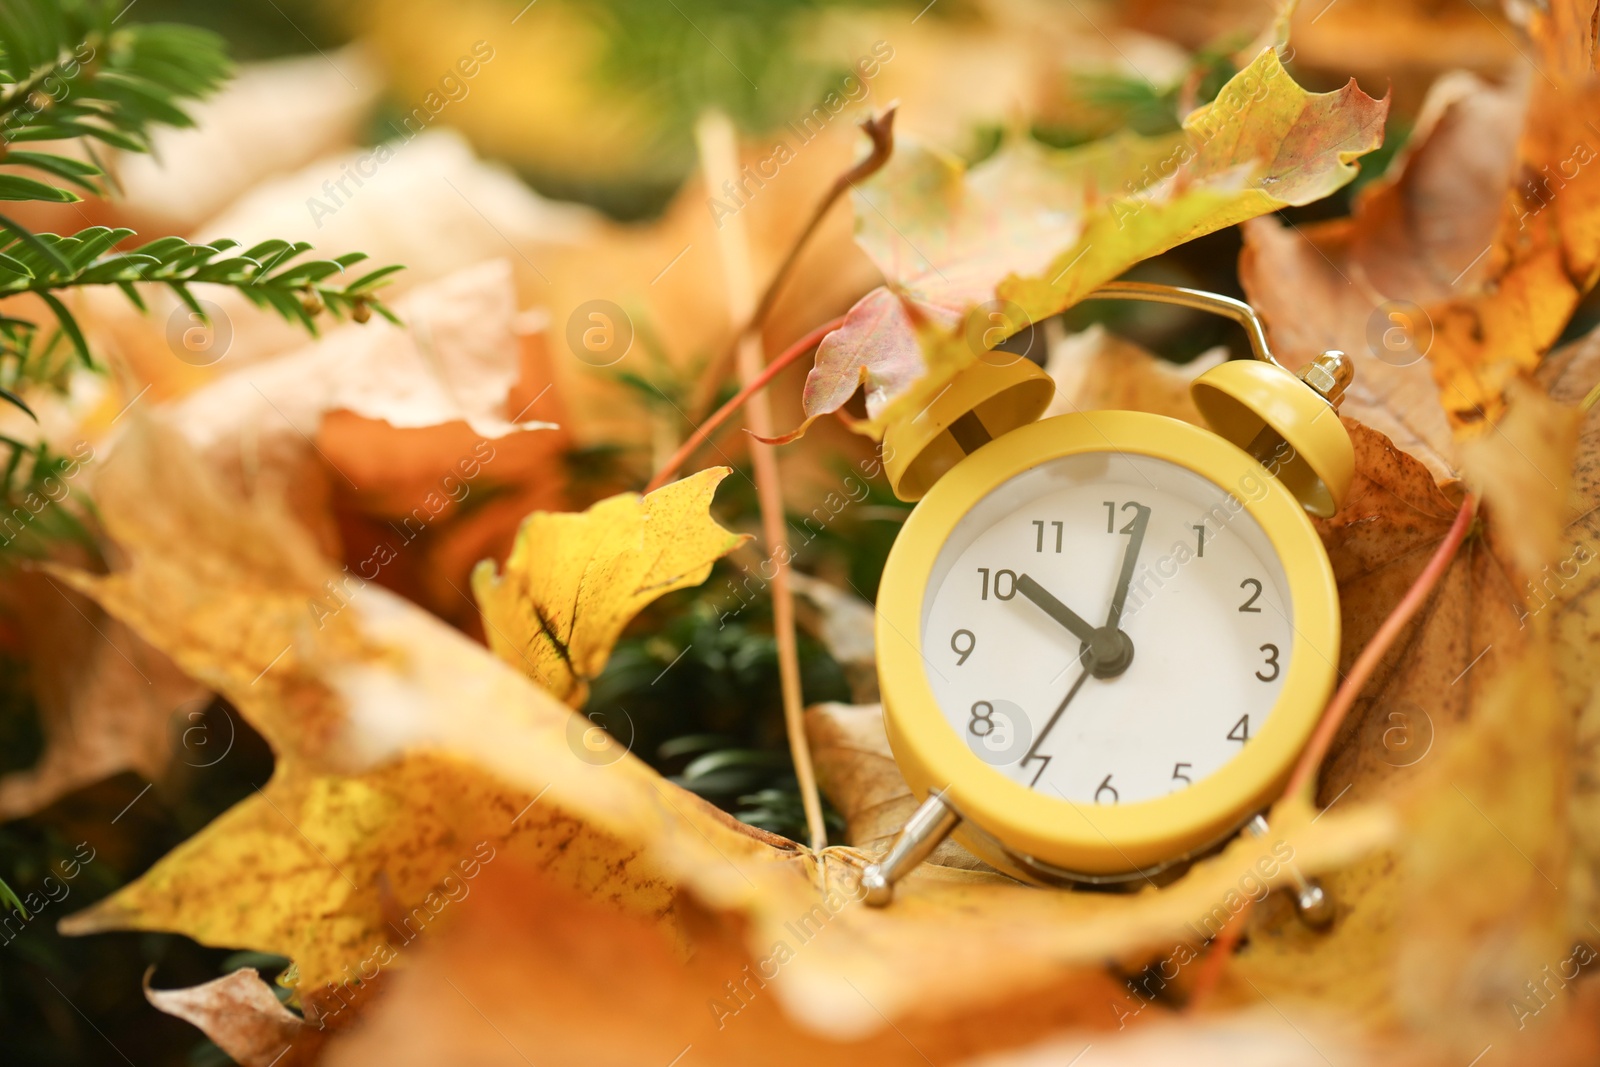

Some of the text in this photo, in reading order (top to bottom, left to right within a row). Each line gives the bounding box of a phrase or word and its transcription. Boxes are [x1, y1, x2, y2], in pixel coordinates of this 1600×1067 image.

[1103, 501, 1142, 535] 12
[1032, 520, 1063, 553] 11
[1192, 525, 1205, 557] 1
[977, 568, 1018, 601] 10
[1238, 577, 1263, 612] 2
[950, 628, 976, 666] 9
[1255, 643, 1280, 682] 3
[968, 701, 995, 737] 8
[1226, 714, 1250, 747] 4
[1029, 753, 1052, 789] 7
[1169, 763, 1192, 794] 5
[1094, 774, 1119, 807] 6
